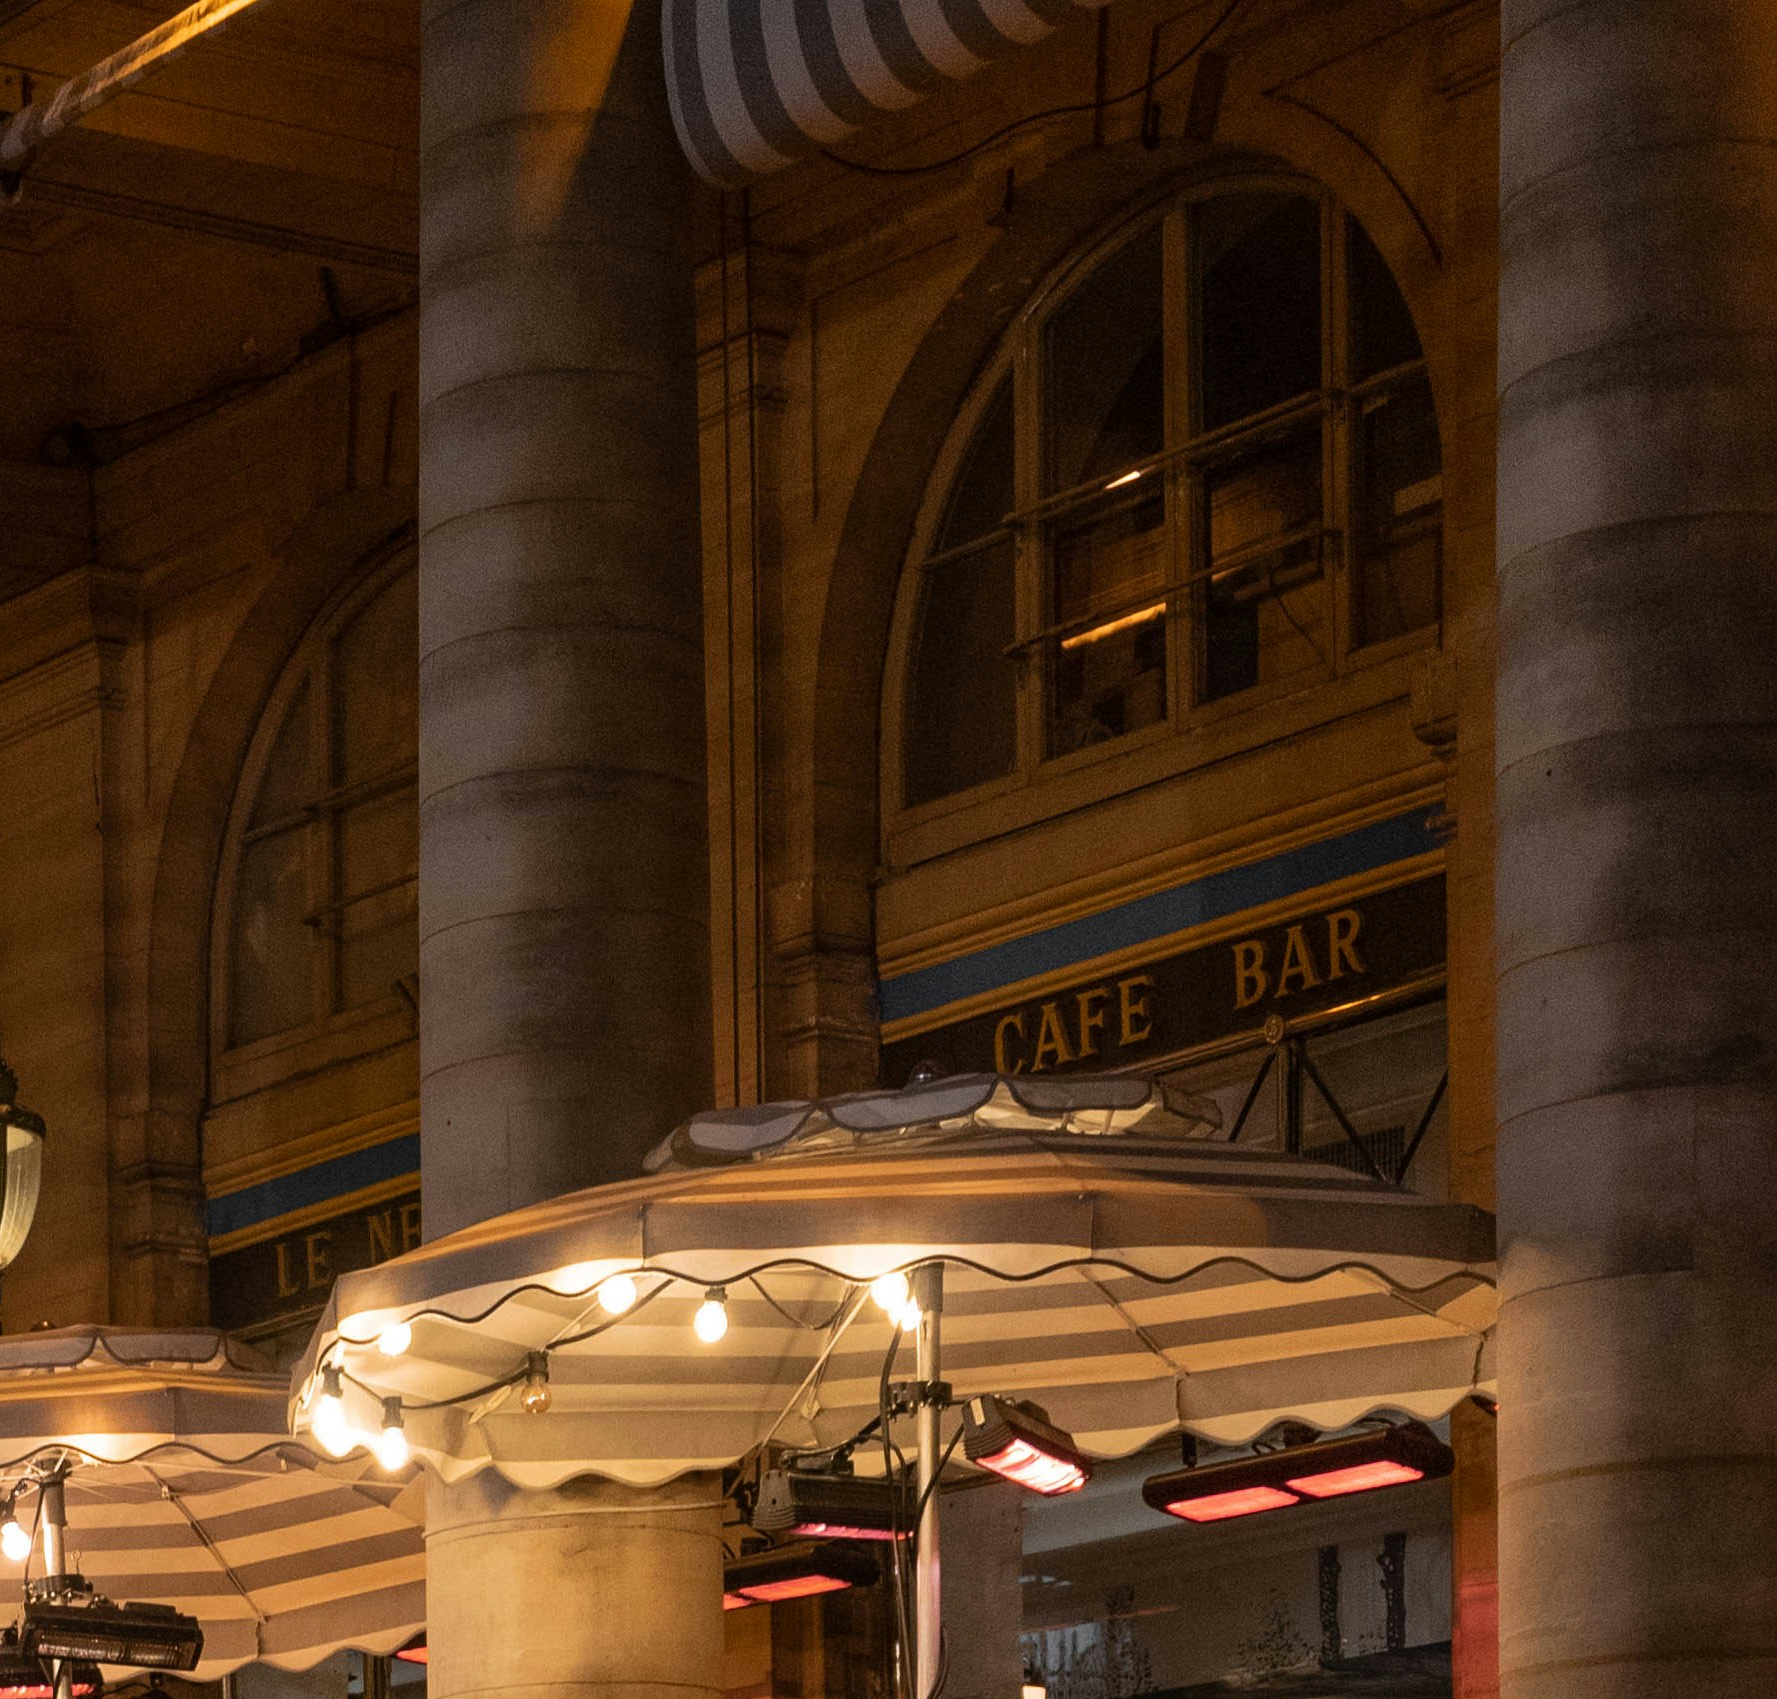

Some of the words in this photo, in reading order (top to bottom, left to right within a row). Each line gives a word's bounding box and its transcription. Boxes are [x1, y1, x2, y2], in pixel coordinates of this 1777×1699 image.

[993, 975, 1153, 1073] CAFE
[1231, 908, 1366, 1010] BAR
[275, 1231, 331, 1298] LE
